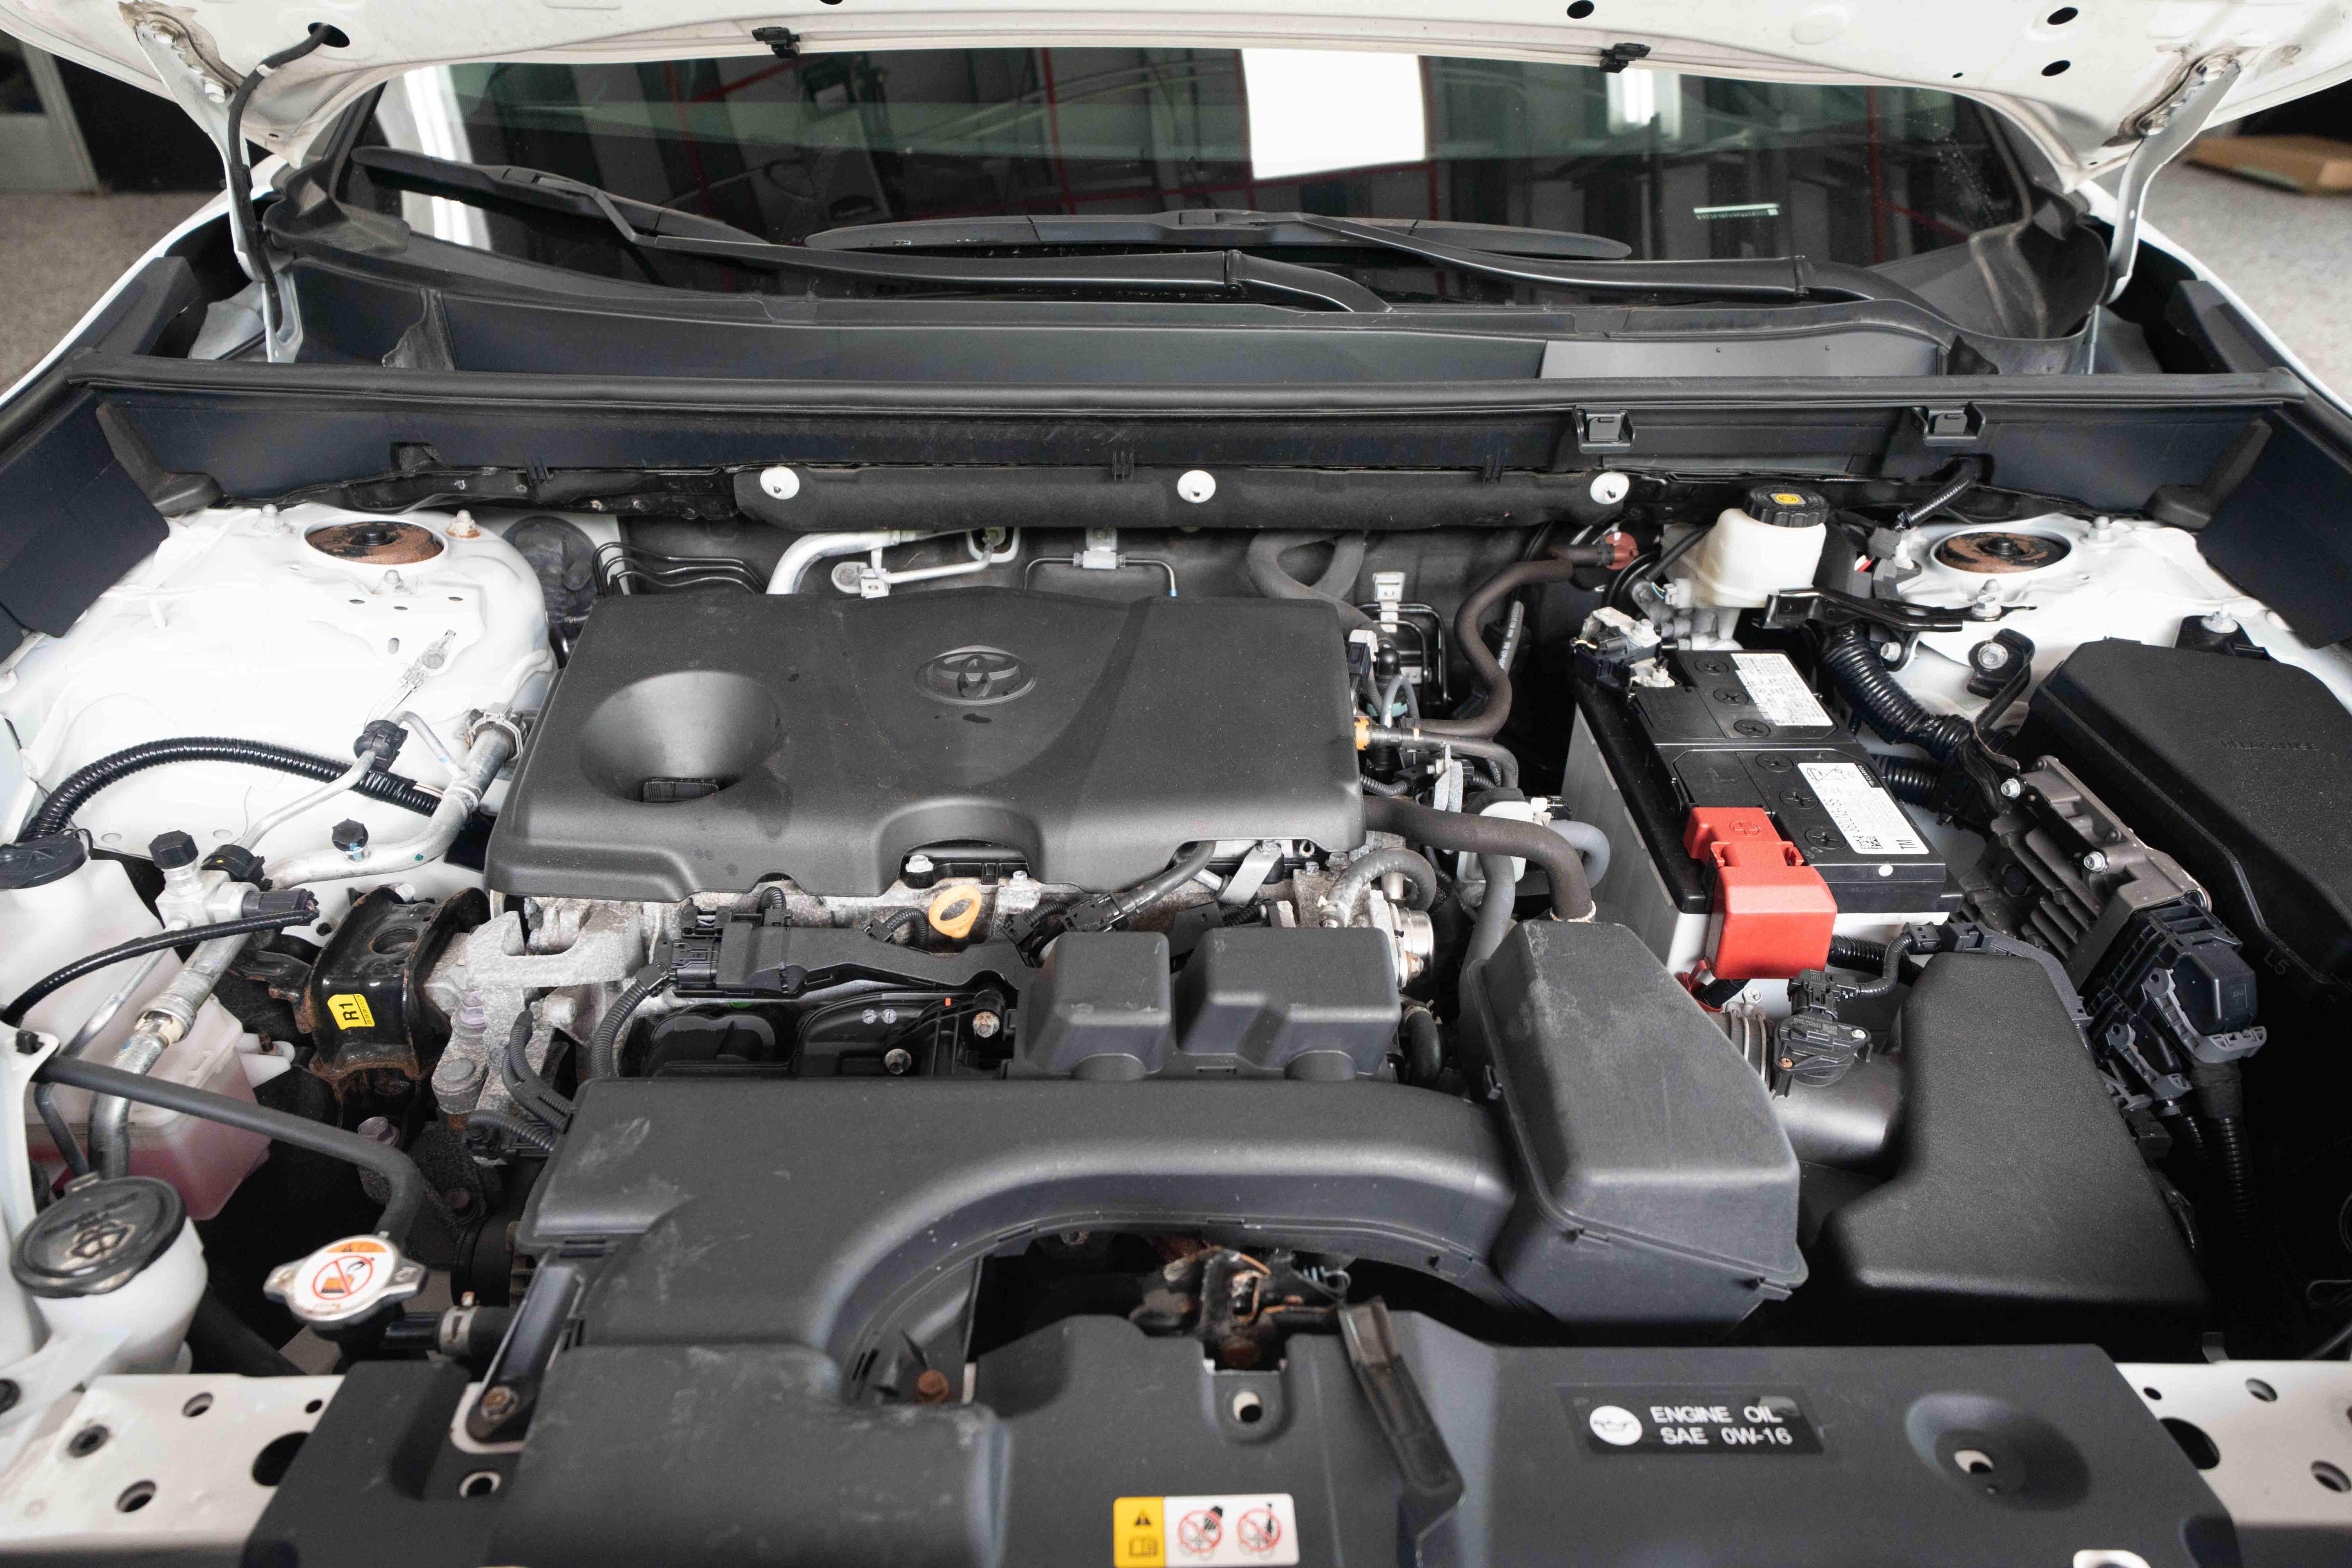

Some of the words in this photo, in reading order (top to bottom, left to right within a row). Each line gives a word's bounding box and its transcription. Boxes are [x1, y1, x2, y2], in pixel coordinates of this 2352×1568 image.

[1858, 765, 1871, 780] CLARIOS
[1896, 840, 1918, 849] TM
[2263, 947, 2290, 975] L5
[339, 1003, 360, 1021] R1
[1650, 1406, 1733, 1423] ENGINE
[1744, 1406, 1783, 1423] OIL
[1660, 1427, 1709, 1445] SAE
[1721, 1427, 1793, 1445] 0W-16
